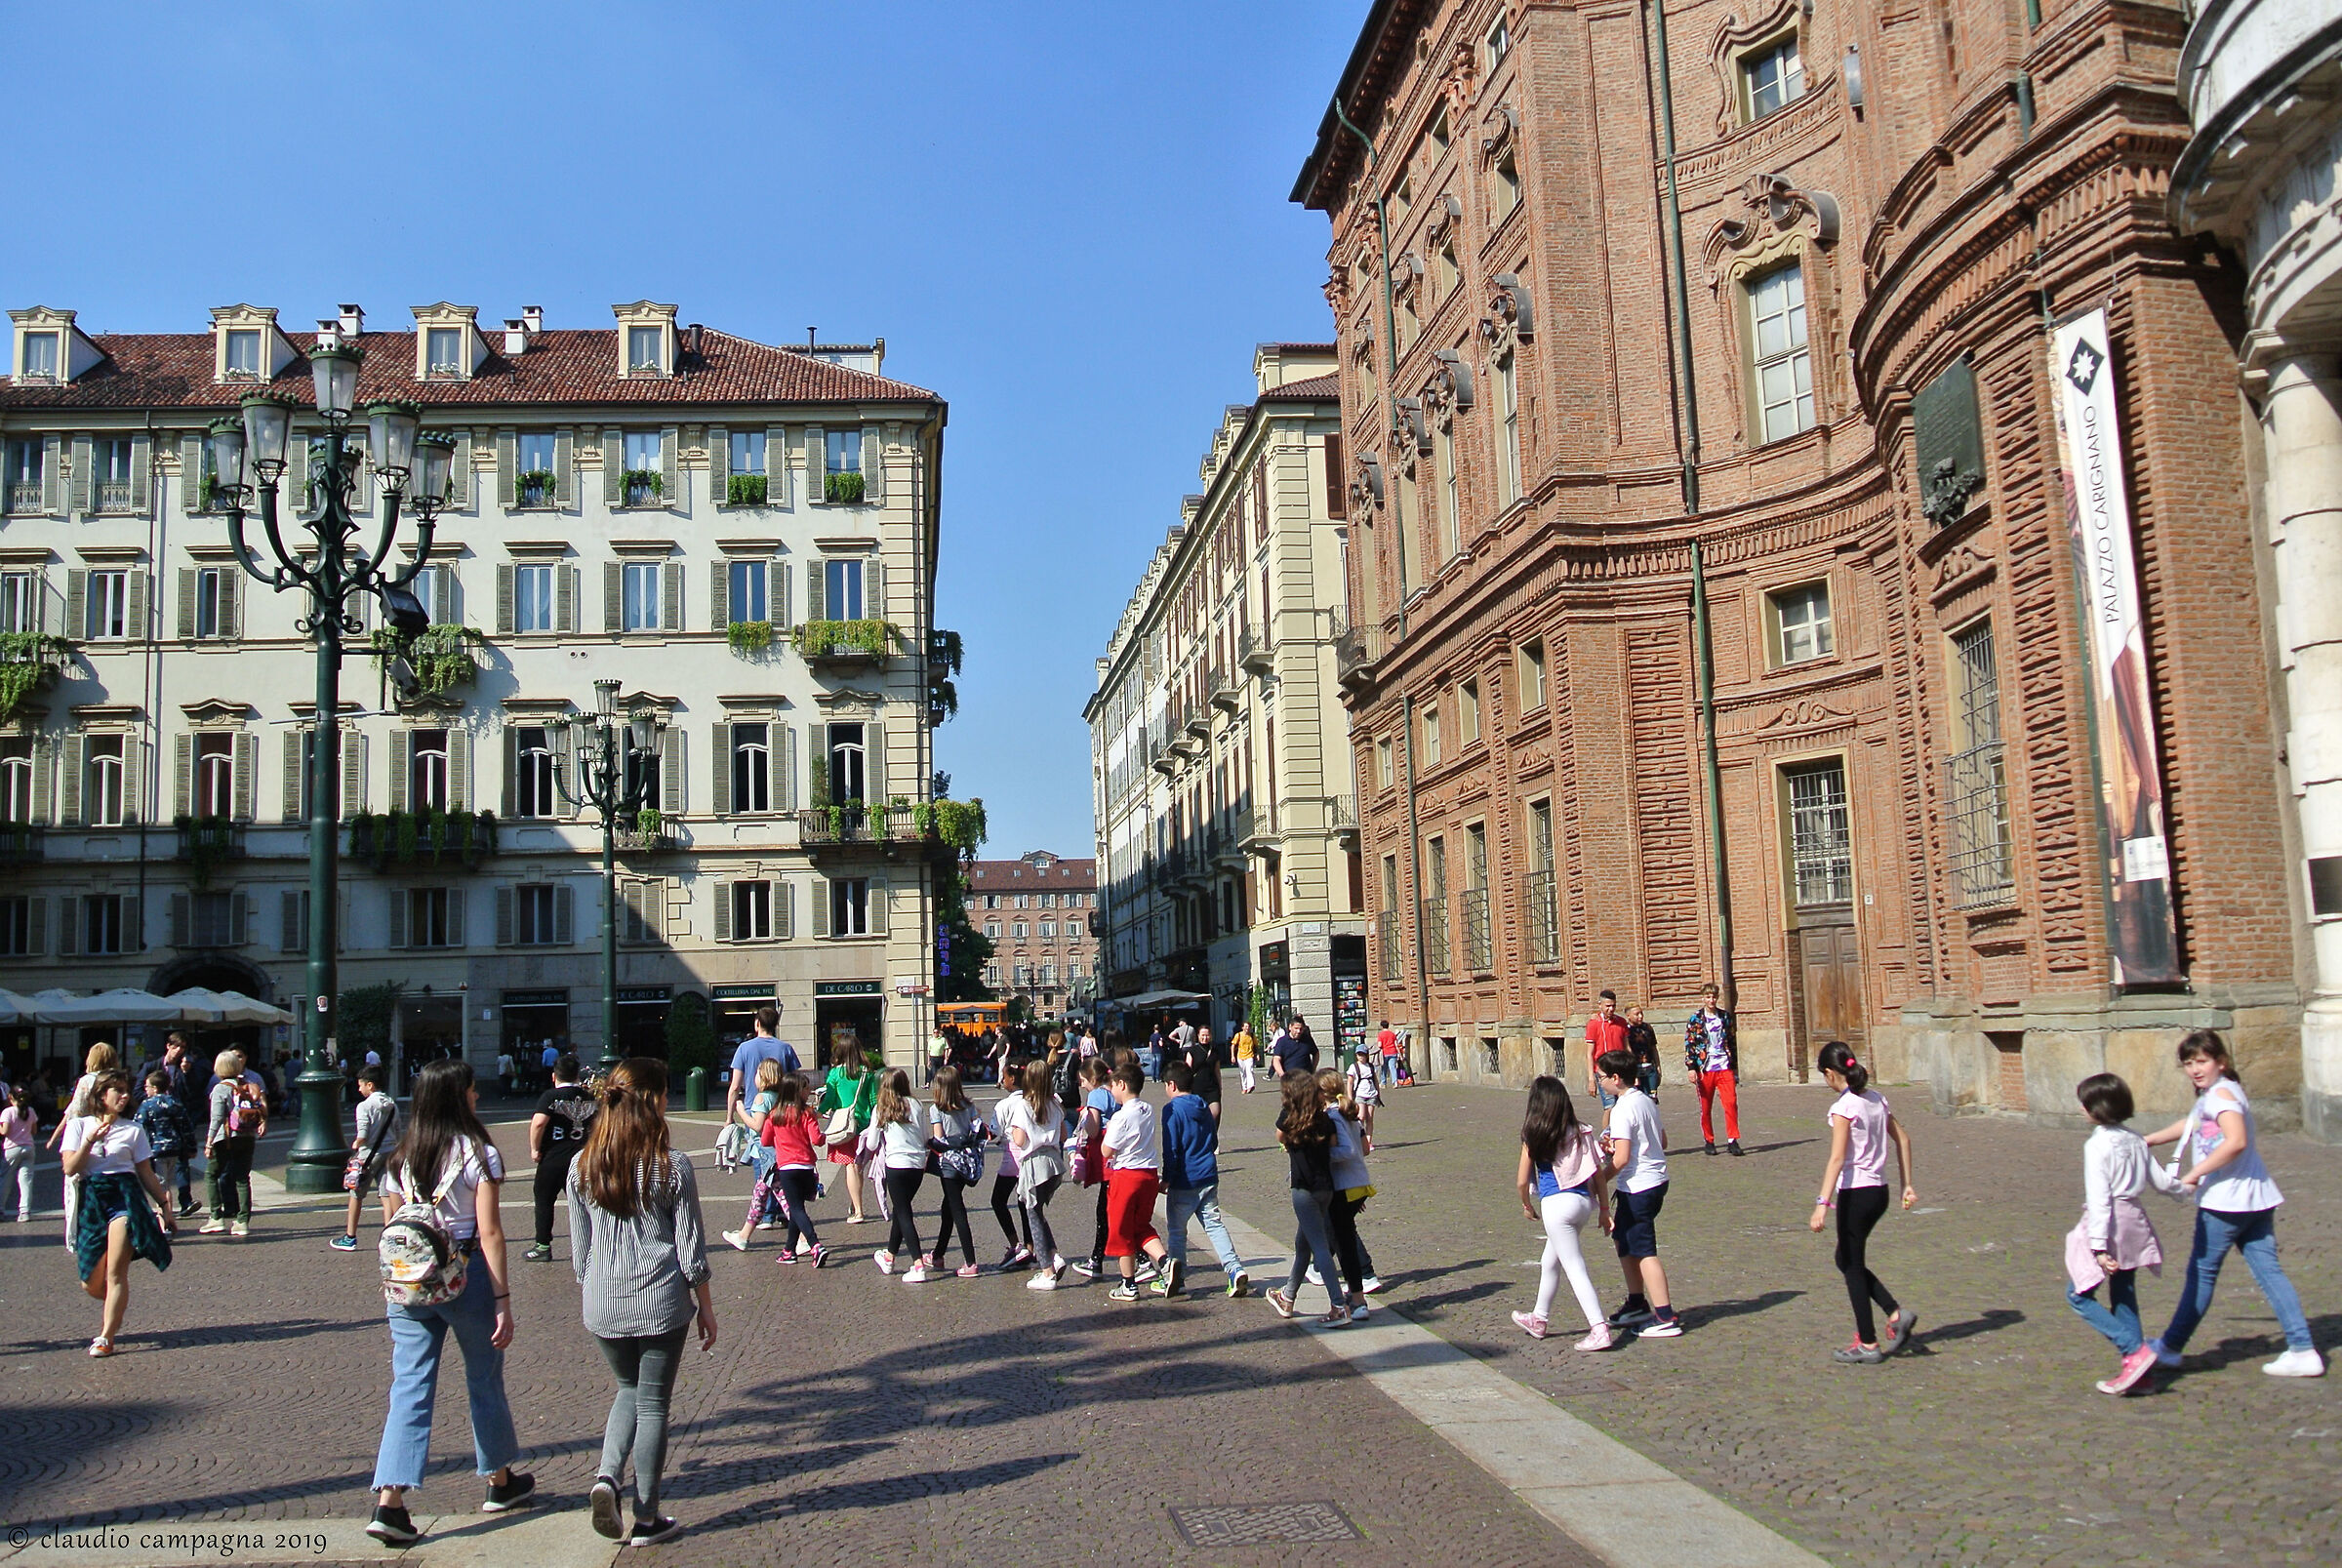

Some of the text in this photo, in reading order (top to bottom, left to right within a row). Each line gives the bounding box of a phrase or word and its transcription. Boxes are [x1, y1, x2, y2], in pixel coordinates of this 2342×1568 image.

[2083, 405, 2120, 623] PALAZZO CARIGNANO
[825, 984, 863, 993] DE CARLO
